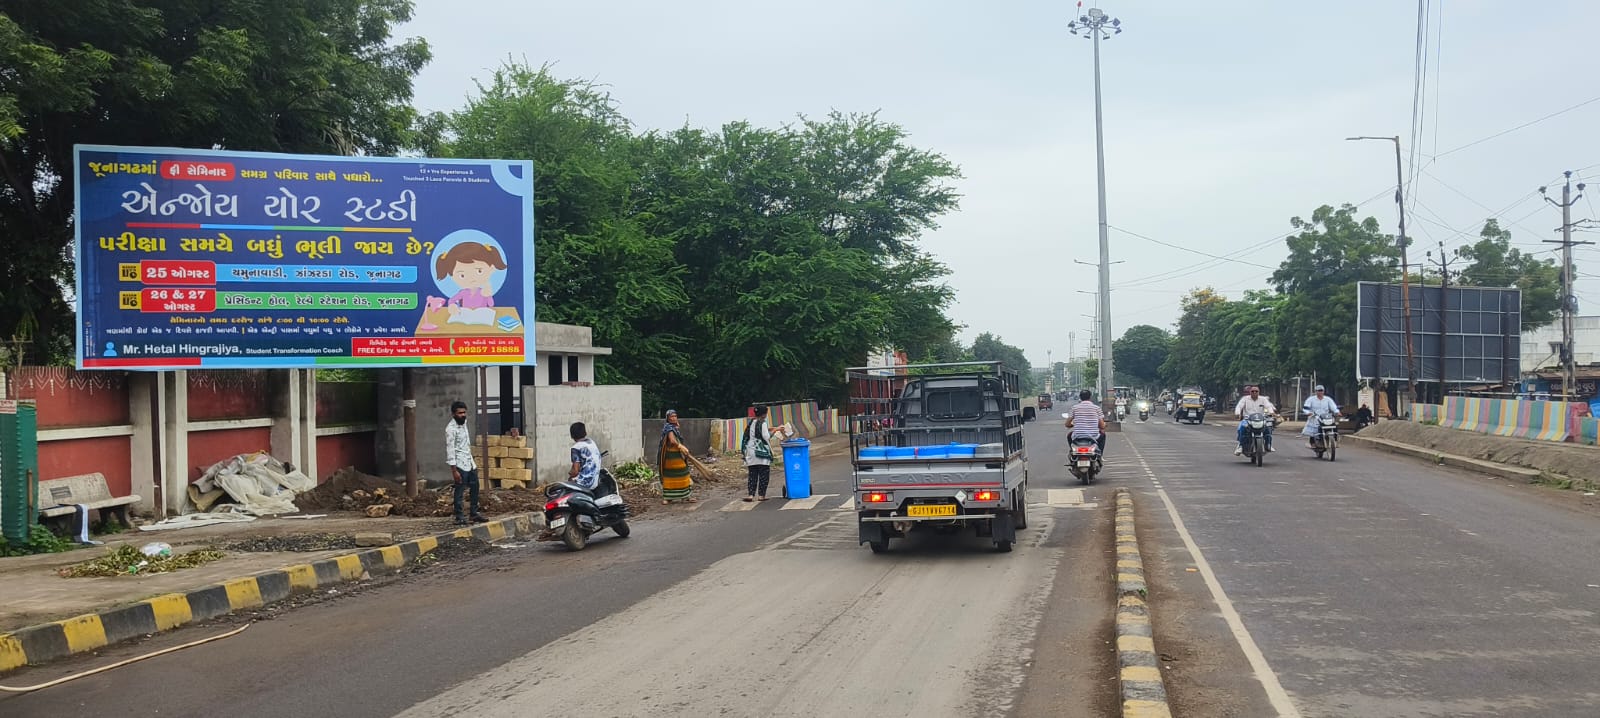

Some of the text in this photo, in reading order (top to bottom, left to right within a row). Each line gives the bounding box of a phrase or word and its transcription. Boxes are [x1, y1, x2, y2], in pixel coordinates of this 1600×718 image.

[88, 160, 157, 178] જૂનાગઢમાં
[187, 164, 227, 177] સેમિનાર
[240, 169, 267, 179] સમગ્ર
[274, 168, 309, 181] પરિવાર
[315, 170, 336, 182] સાથે
[120, 182, 416, 224] એન્જોય યોર સ્ટડી
[98, 231, 435, 259] પરીક્ષા સમયે બધું ભૂલી જાય છે?
[146, 267, 167, 279] 25
[171, 267, 210, 279] ઓગસ્ટ
[366, 269, 401, 281] જૂનાગઢ
[151, 289, 206, 300] 26 & 27
[164, 301, 196, 311] ઓગસ્ટ
[320, 295, 347, 306] સ્ટેશન
[378, 297, 409, 309] જૂનાગઢ
[123, 344, 141, 354] Mr.
[144, 344, 176, 354] Hetal
[179, 343, 243, 355] Hingrajiya,
[890, 473, 970, 483] CARRY
